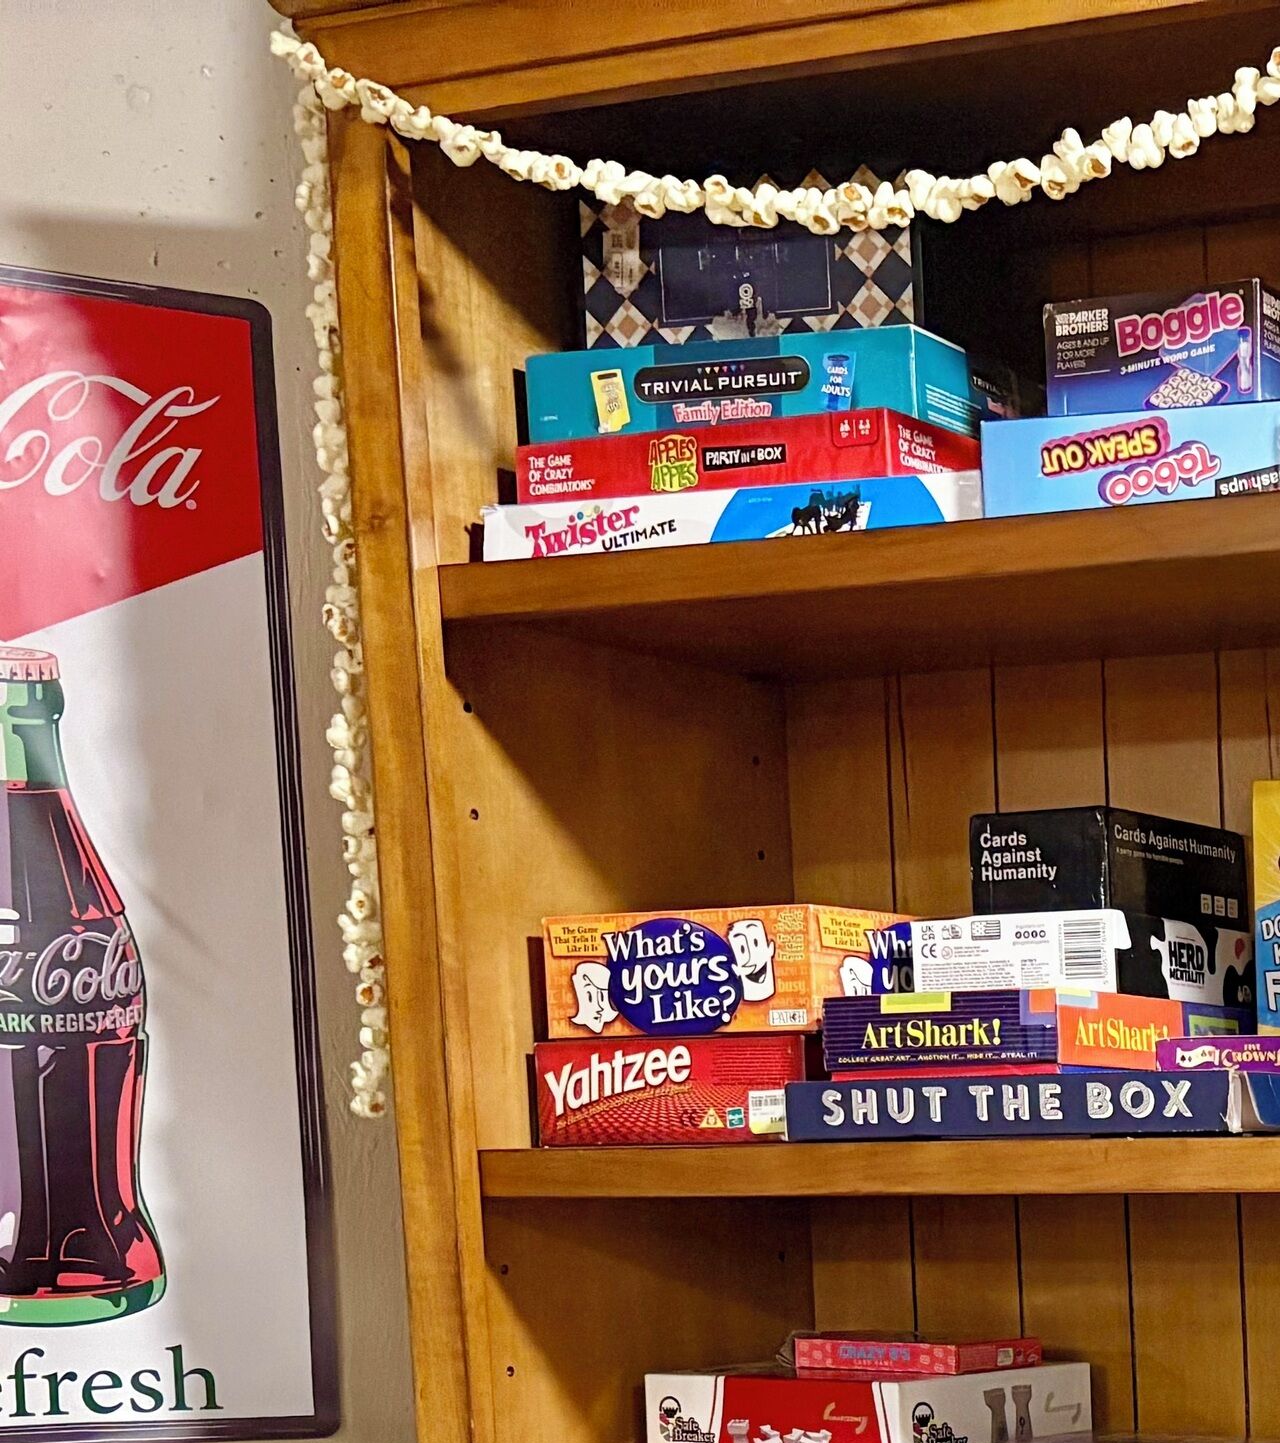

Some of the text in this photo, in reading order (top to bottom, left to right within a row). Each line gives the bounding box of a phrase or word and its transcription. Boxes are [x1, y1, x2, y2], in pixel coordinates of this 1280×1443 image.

[1115, 291, 1244, 357] Boggle
[642, 372, 801, 395] TRIVIAL PURSUIT
[673, 400, 771, 424] Family Edition
[1043, 424, 1161, 475] SPEAK OUT
[1101, 441, 1221, 506] Taboo
[525, 503, 639, 558] Twister
[603, 519, 676, 550] ULTIMATE
[981, 832, 1027, 847] Cards
[981, 848, 1041, 865] Against
[982, 865, 1056, 881] Humanity
[603, 924, 705, 961] What's
[622, 956, 728, 1004] yours
[41, 1005, 142, 1033] REGISTERED
[651, 986, 736, 1023] Like?
[544, 1045, 691, 1117] Yahtzee
[822, 1079, 1193, 1126] SHUT THE BOX
[0, 1344, 224, 1417] fresh
